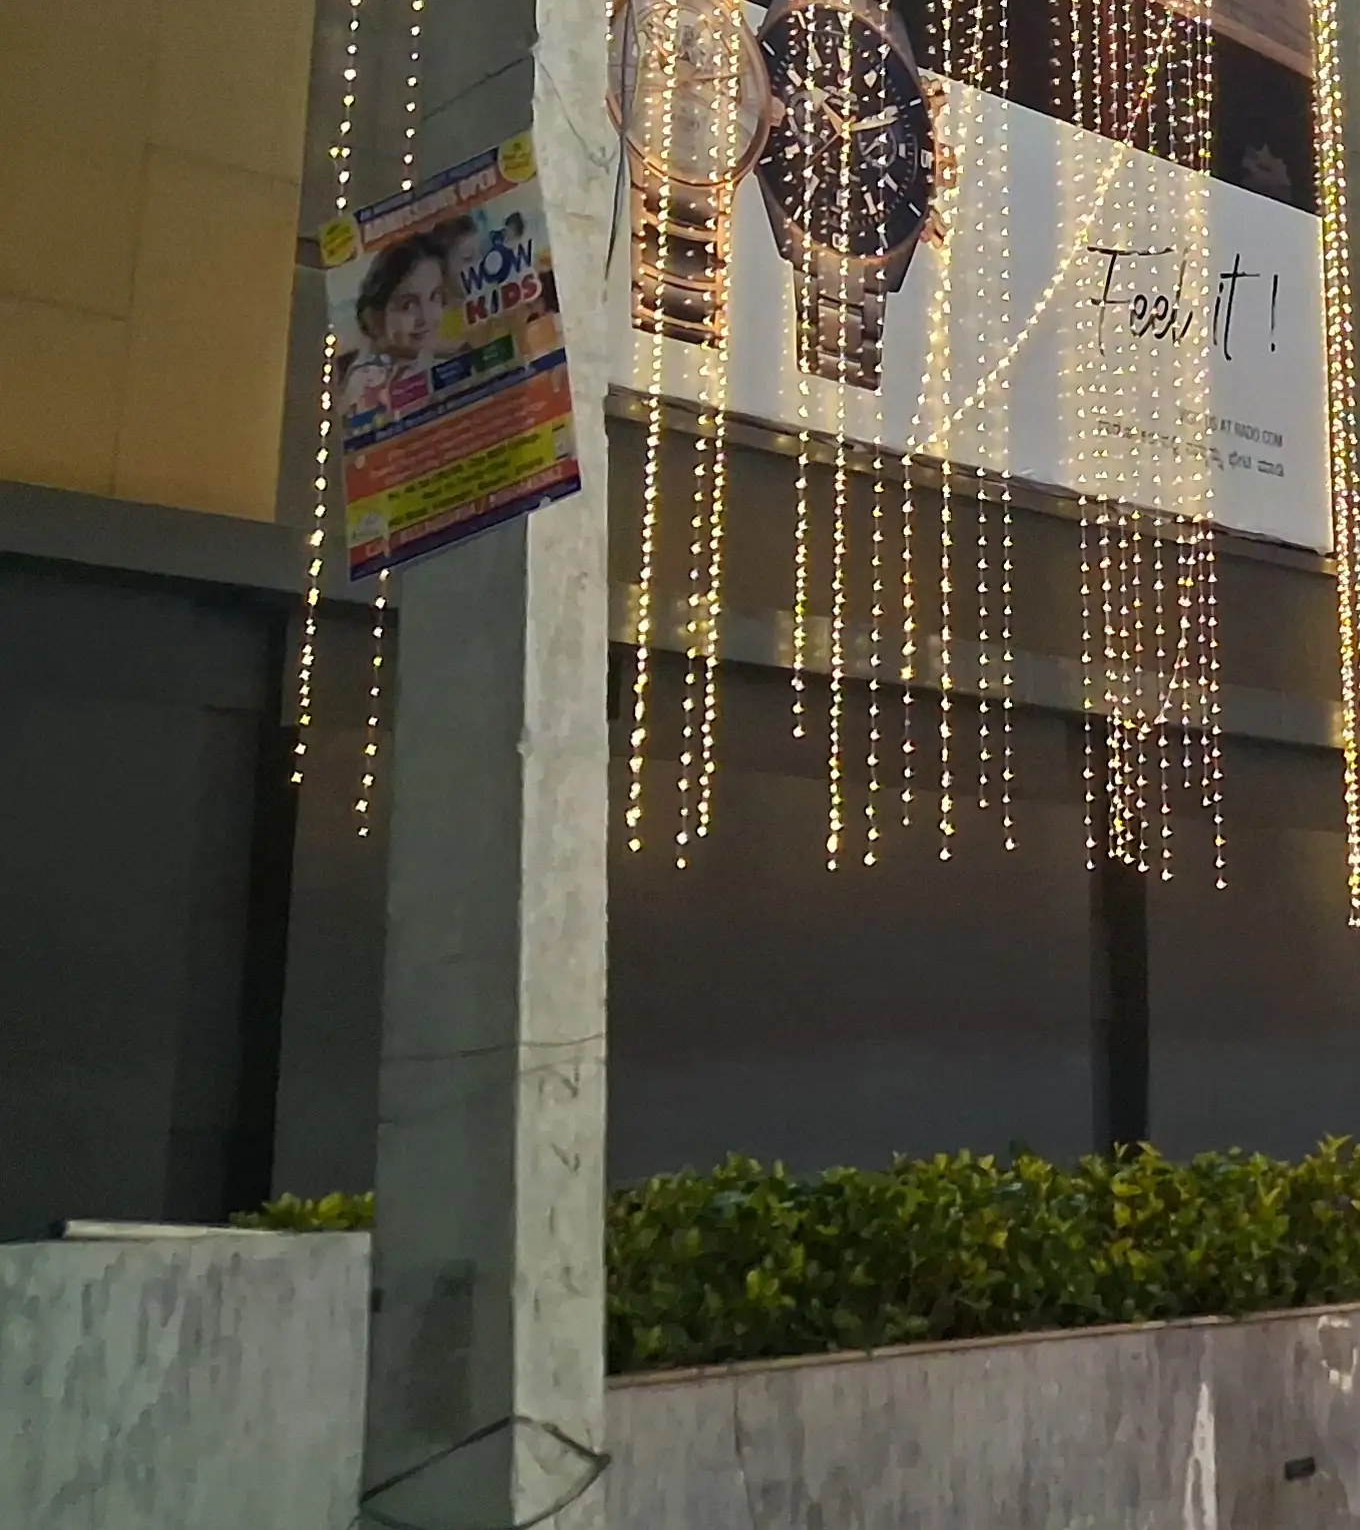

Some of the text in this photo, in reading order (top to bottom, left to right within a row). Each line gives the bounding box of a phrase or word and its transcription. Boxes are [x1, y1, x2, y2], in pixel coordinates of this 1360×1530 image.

[461, 238, 532, 295] WOW
[465, 273, 538, 325] KIDS
[1087, 245, 1193, 357] Feel
